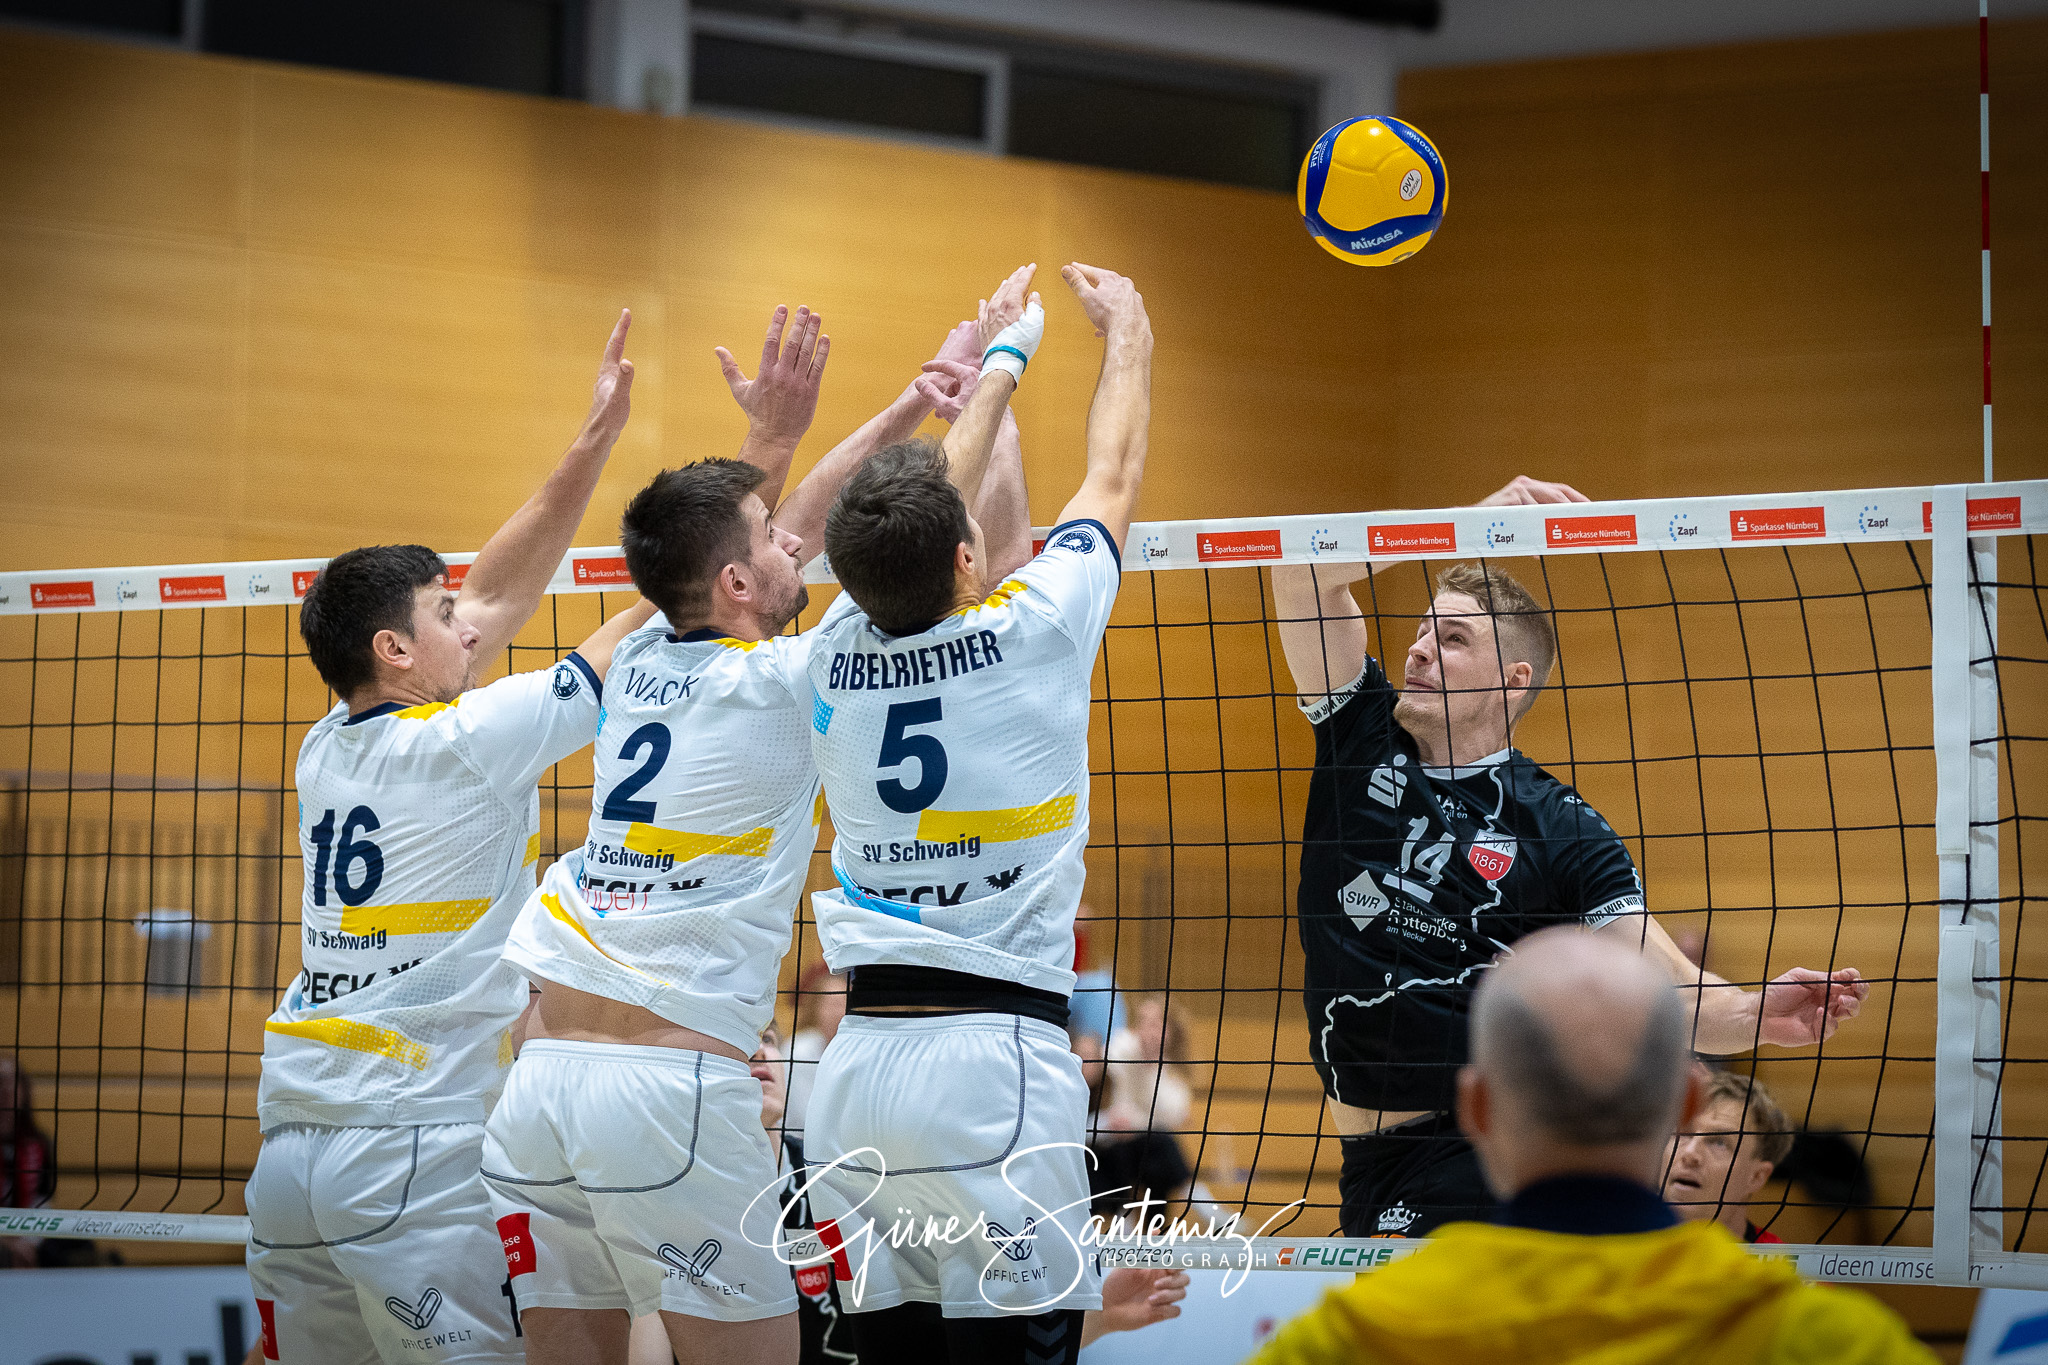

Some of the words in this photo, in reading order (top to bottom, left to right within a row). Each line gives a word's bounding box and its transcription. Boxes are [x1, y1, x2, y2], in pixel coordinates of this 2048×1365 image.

[1402, 173, 1415, 194] DVV
[1750, 522, 1785, 533] Sparkasse
[1786, 520, 1819, 533] Nürnberg
[1868, 517, 1889, 530] Zapf
[1981, 511, 2014, 523] Nürnberg
[1494, 533, 1515, 545] Zapf
[1565, 529, 1598, 540] Sparkasse
[1599, 528, 1631, 539] Nürnberg
[1677, 526, 1698, 537] Zapf
[1214, 544, 1246, 555] Sparkasse
[1247, 542, 1276, 554] Nürnberg
[1318, 540, 1339, 551] Zapf
[1386, 536, 1418, 548] Sparkasse
[1419, 535, 1450, 547] Nürnberg
[1149, 547, 1169, 559] Zapf
[588, 570, 615, 579] Sparkasse
[123, 591, 138, 600] Zapf
[255, 584, 270, 593] Zapf
[828, 629, 1003, 690] BIBELRIETHER
[624, 667, 700, 706] WACK
[875, 696, 948, 814] 5
[601, 721, 671, 824] 2
[862, 844, 881, 863] SV
[889, 834, 981, 863] Schwaig
[1394, 815, 1456, 885] 14
[1482, 835, 1511, 853] TVR
[310, 804, 384, 907] 16
[599, 845, 675, 873] Schwaig
[1473, 852, 1504, 873] 1861
[1345, 890, 1380, 909] SWR
[1604, 900, 1625, 915] WIR
[307, 926, 317, 947] SV
[320, 927, 387, 950] Schwaig
[1385, 925, 1399, 935] am
[1388, 909, 1467, 951] Rottenbrg
[72, 1218, 112, 1234] Ideen
[113, 1221, 184, 1237] umsetzen
[1096, 1244, 1173, 1263] msetzen
[1303, 1247, 1394, 1266] FUCHS
[1819, 1254, 1874, 1277] Ideen
[799, 1270, 827, 1288] 1861
[402, 1329, 473, 1351] OFFICEWELT
